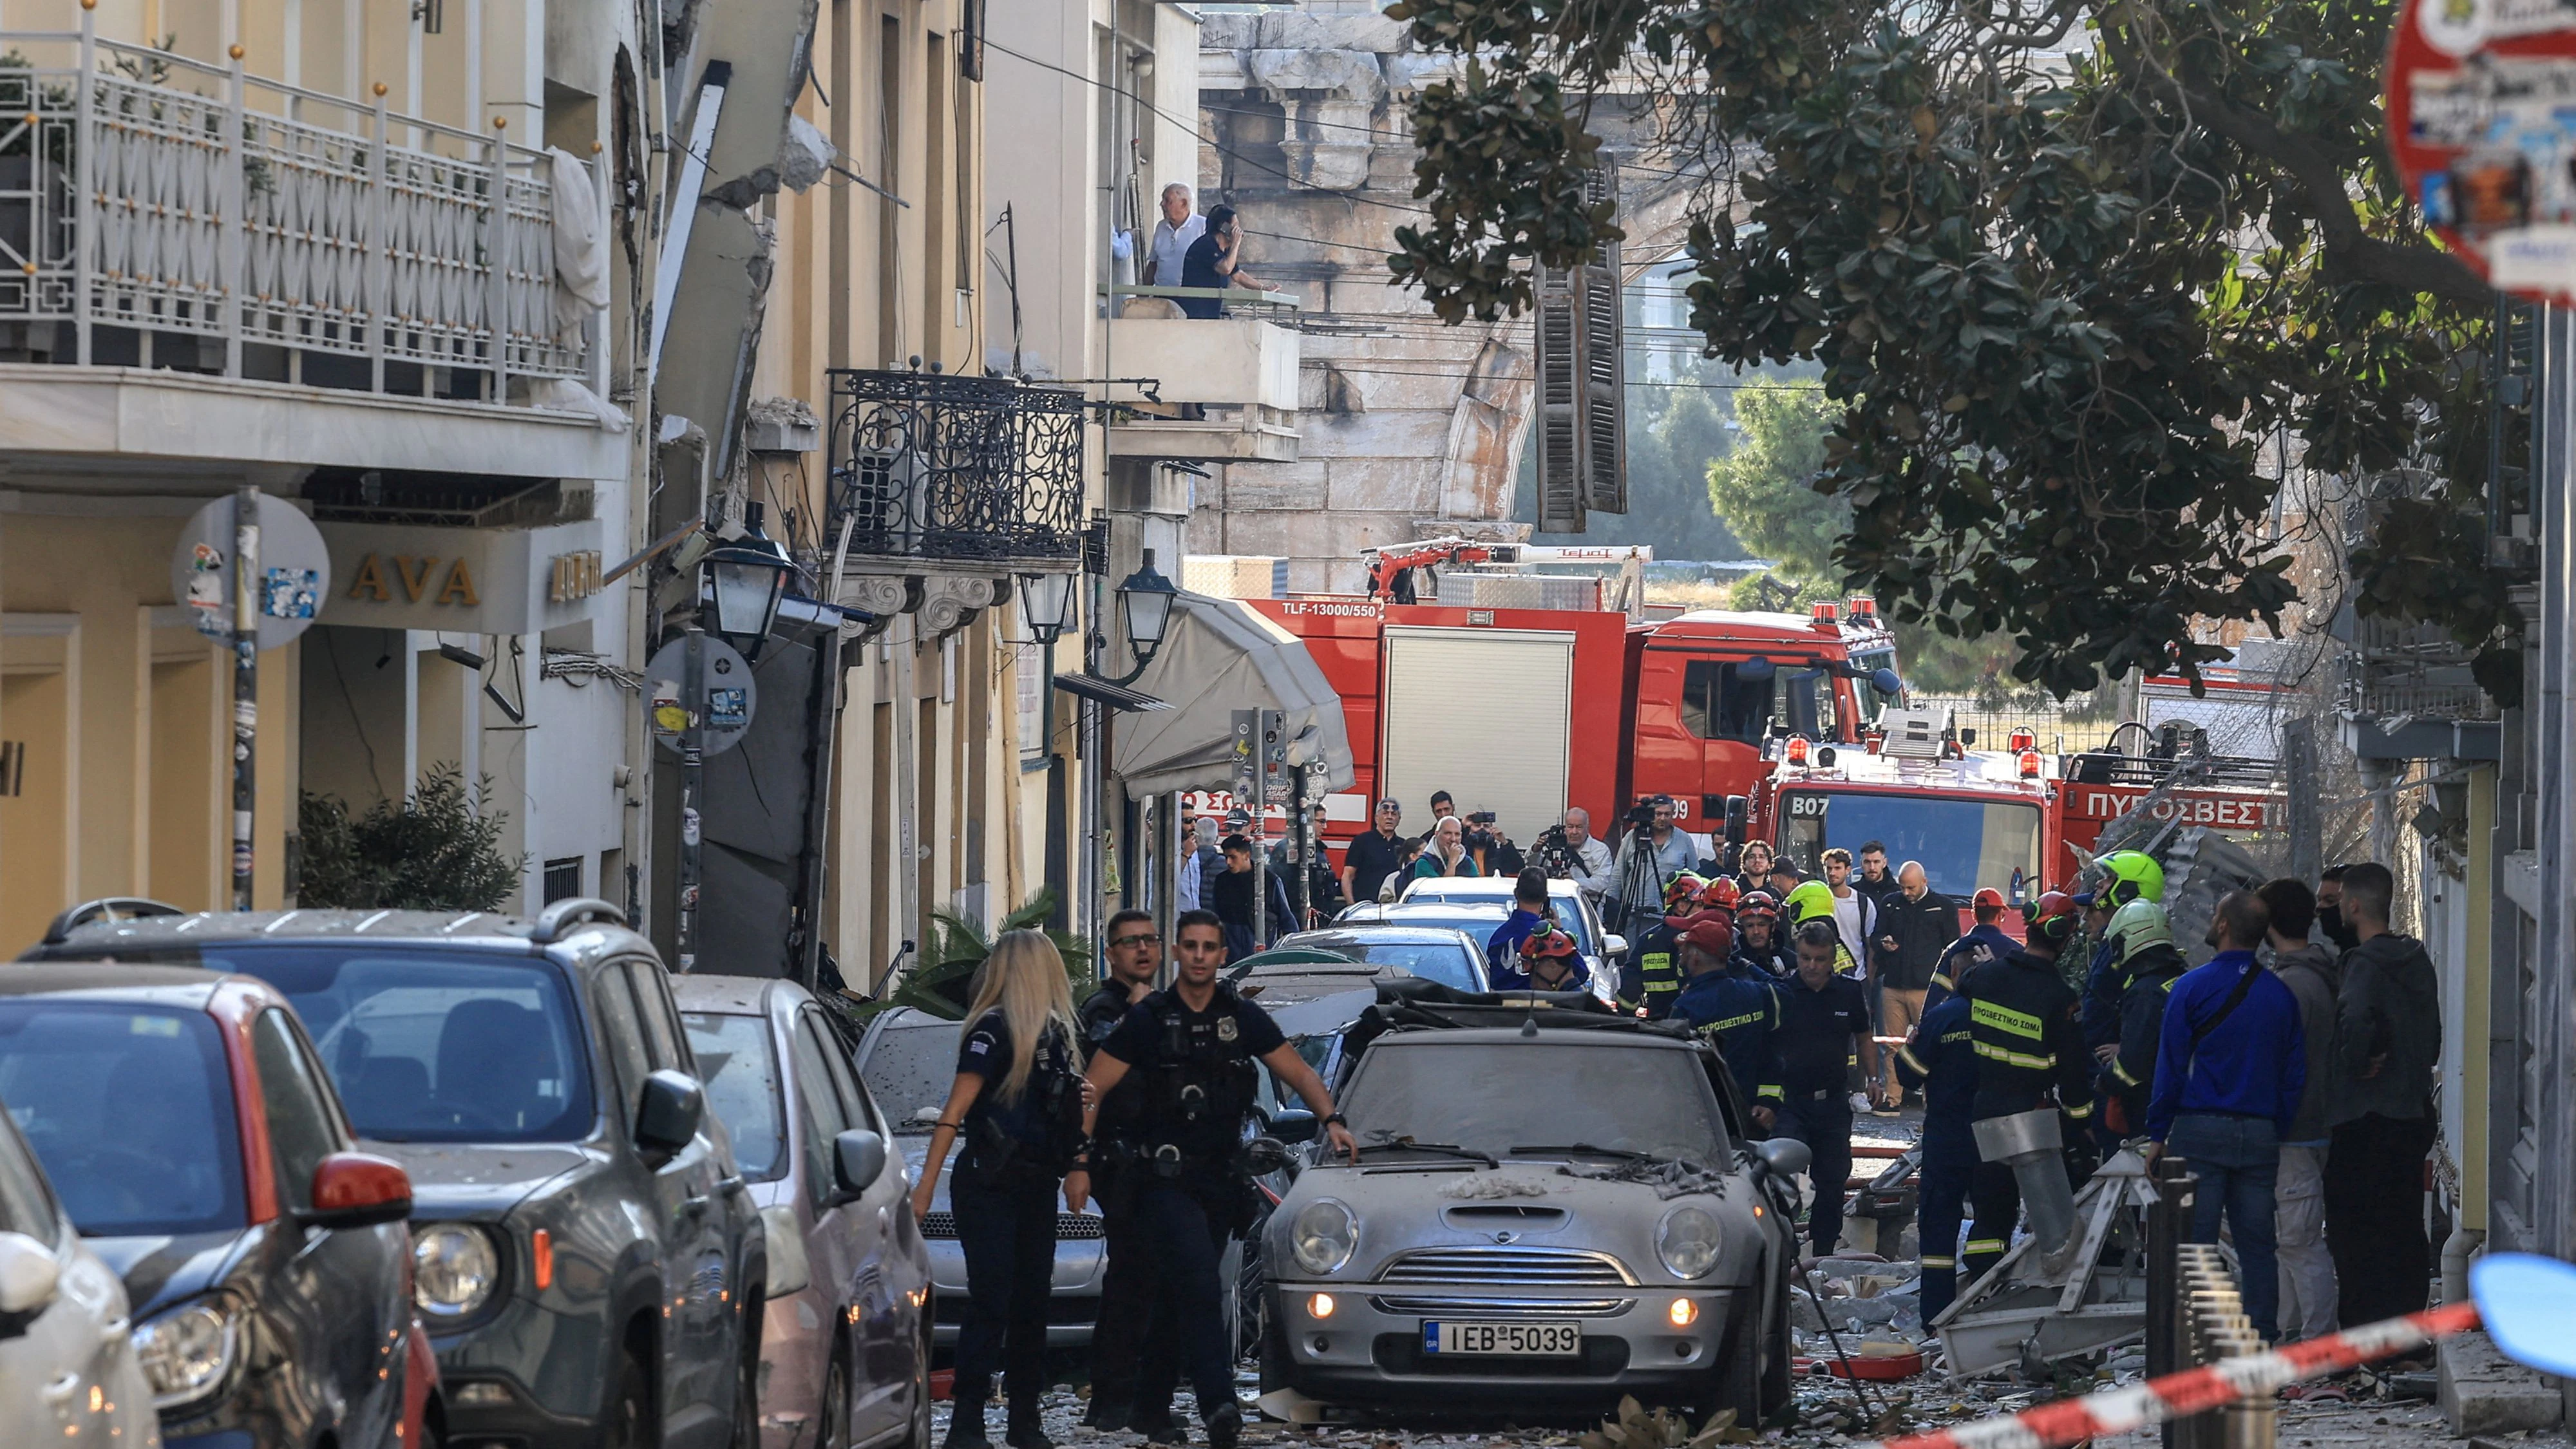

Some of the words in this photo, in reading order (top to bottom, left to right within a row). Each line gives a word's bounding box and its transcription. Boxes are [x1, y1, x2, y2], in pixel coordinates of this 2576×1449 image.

[350, 552, 480, 605] AVA
[1282, 602, 1376, 617] TLF-13000/550
[1792, 797, 1829, 815] B07
